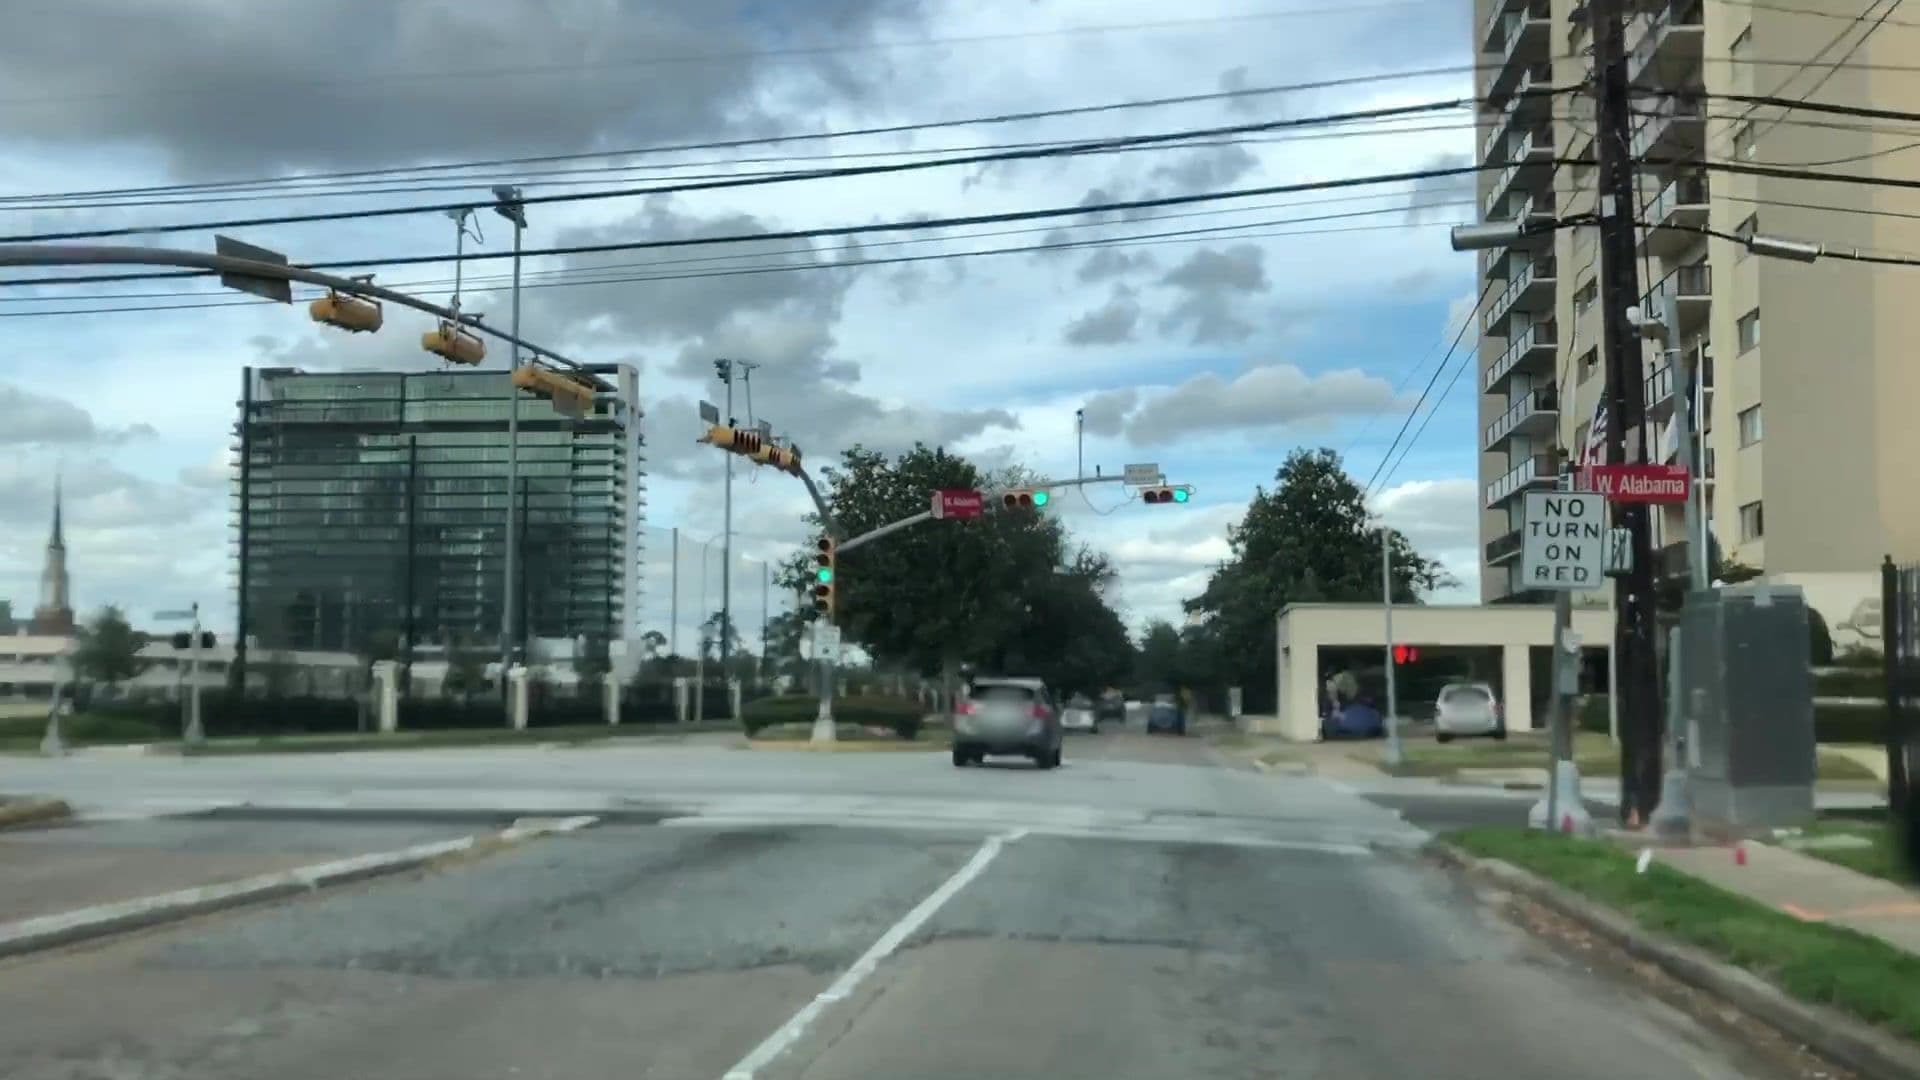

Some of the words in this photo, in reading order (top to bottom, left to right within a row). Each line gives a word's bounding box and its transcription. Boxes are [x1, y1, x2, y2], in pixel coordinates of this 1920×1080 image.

[1619, 475, 1684, 494] Alabama
[1545, 498, 1584, 517] NO
[1530, 521, 1599, 538] TURN
[1545, 544, 1581, 561] ON
[1535, 565, 1589, 582] RED
